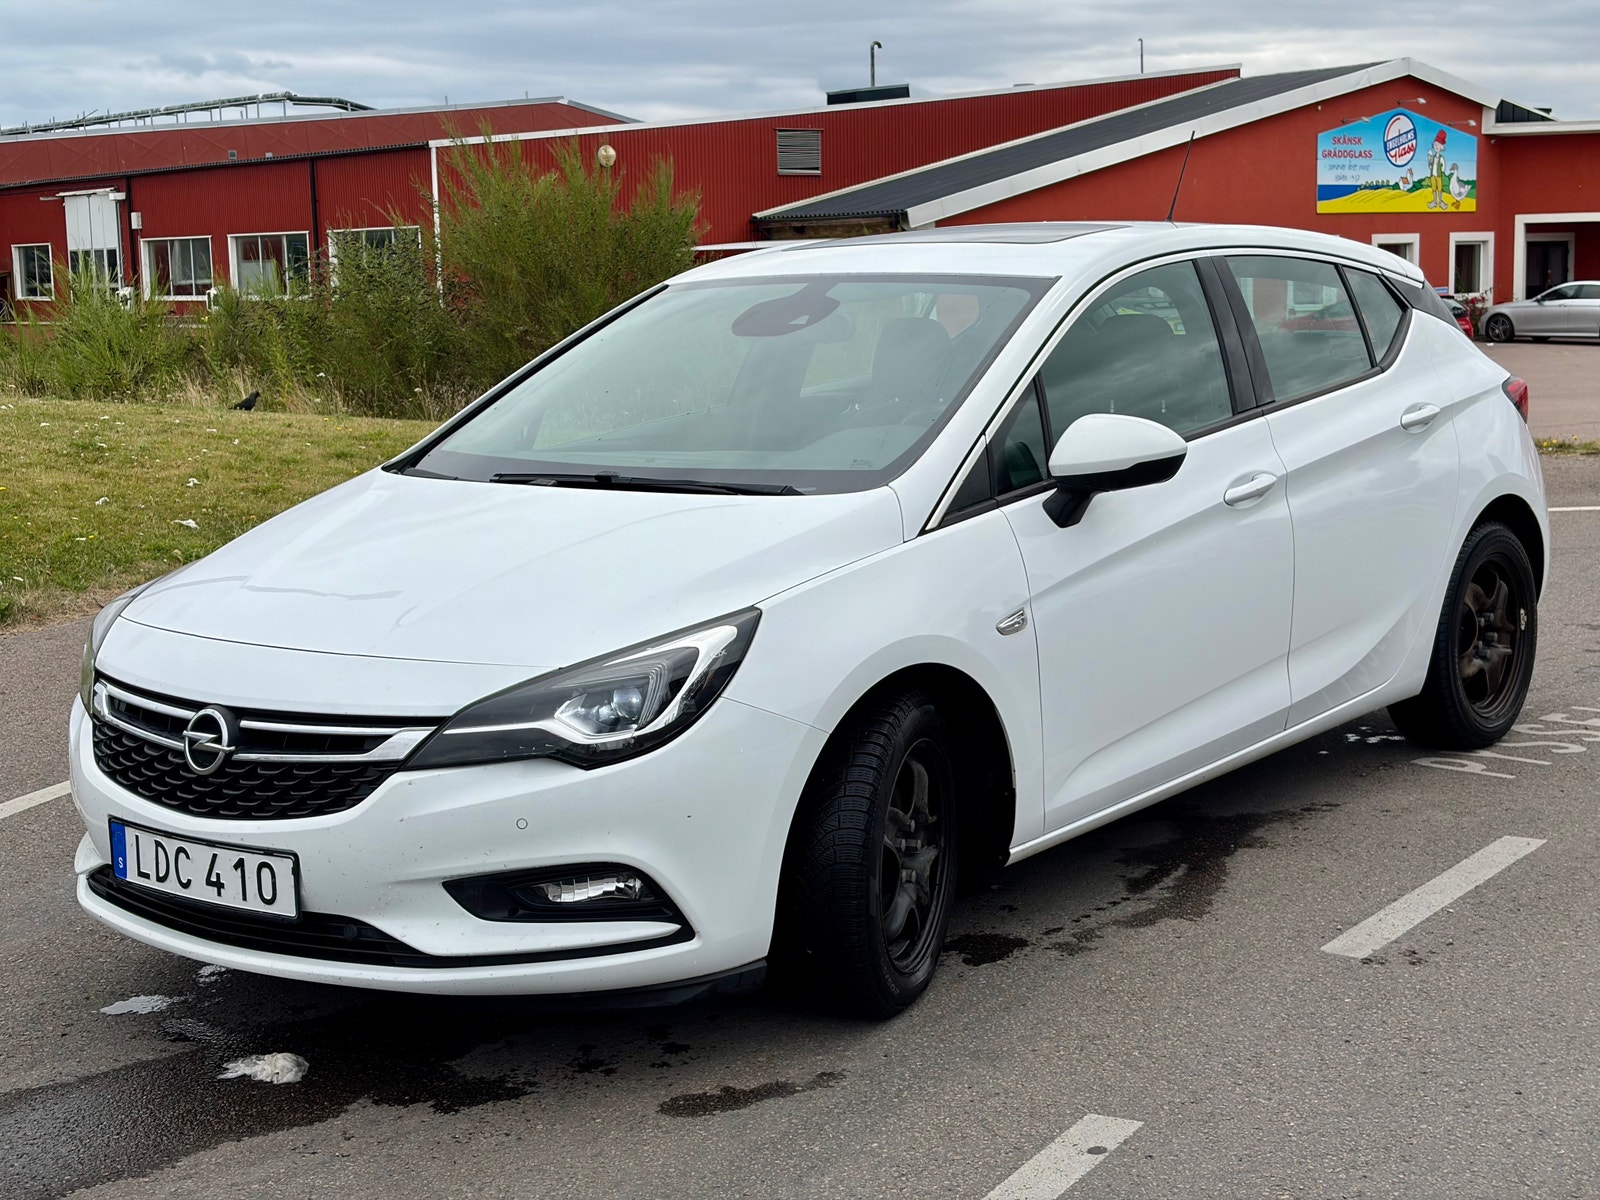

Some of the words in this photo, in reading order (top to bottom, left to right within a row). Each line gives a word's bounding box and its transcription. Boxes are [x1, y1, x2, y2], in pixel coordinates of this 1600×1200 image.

[1331, 134, 1363, 146] SKÅNSK
[1386, 130, 1415, 151] ENGELHOLMS
[1321, 148, 1373, 159] GRÄDDGLASS
[118, 856, 124, 869] S
[135, 834, 192, 889] LDC
[205, 853, 277, 905] 410
